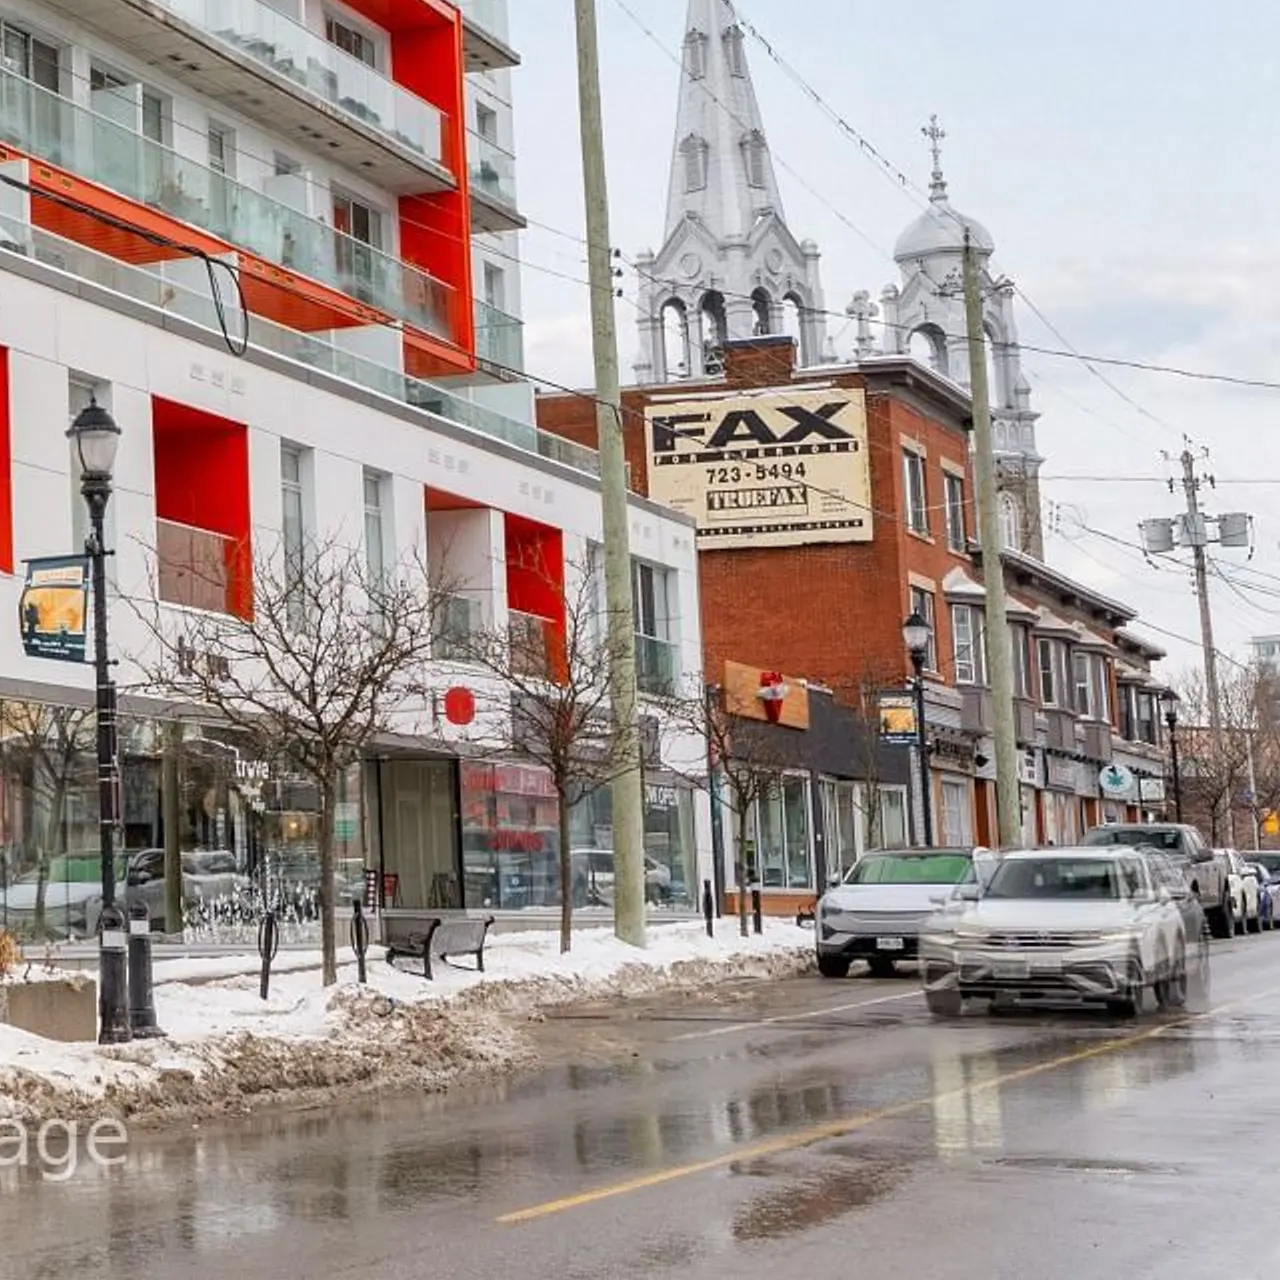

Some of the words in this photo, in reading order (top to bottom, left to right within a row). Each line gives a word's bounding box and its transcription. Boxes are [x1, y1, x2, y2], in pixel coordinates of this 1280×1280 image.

[652, 401, 856, 452] FAX
[655, 452, 697, 465] FOR
[723, 440, 857, 460] EVERYONE
